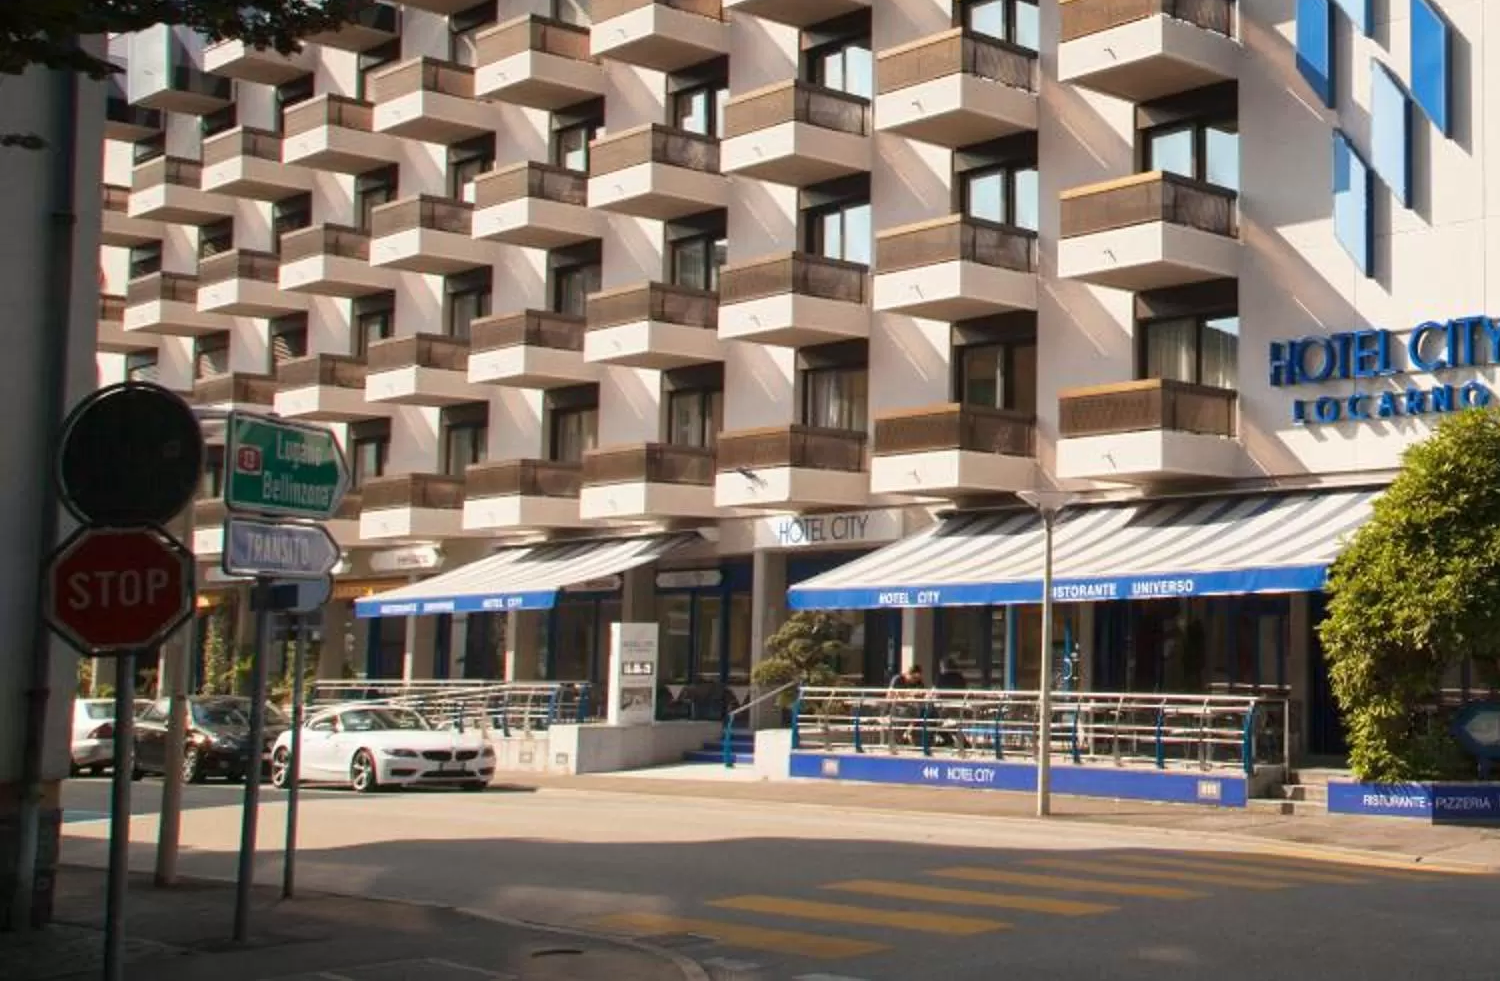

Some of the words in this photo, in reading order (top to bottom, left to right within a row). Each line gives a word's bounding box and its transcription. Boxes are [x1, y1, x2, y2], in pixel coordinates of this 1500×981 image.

[1269, 328, 1401, 386] HOTEL
[1292, 380, 1491, 426] LOCARNO
[276, 430, 322, 470] Lugano
[262, 471, 330, 508] Bellinzona
[779, 518, 826, 543] HOTEL
[831, 515, 869, 540] CITY
[247, 532, 310, 565] TRANSITO
[67, 569, 169, 611] STOP
[879, 591, 909, 604] HOTEL
[917, 590, 941, 603] CITY
[1053, 582, 1117, 599] ISTORANTE
[1131, 578, 1195, 595] UNIVERSO
[947, 767, 973, 781] HOTEL
[975, 768, 995, 782] CITY
[1435, 796, 1492, 810] PIZZERIA
